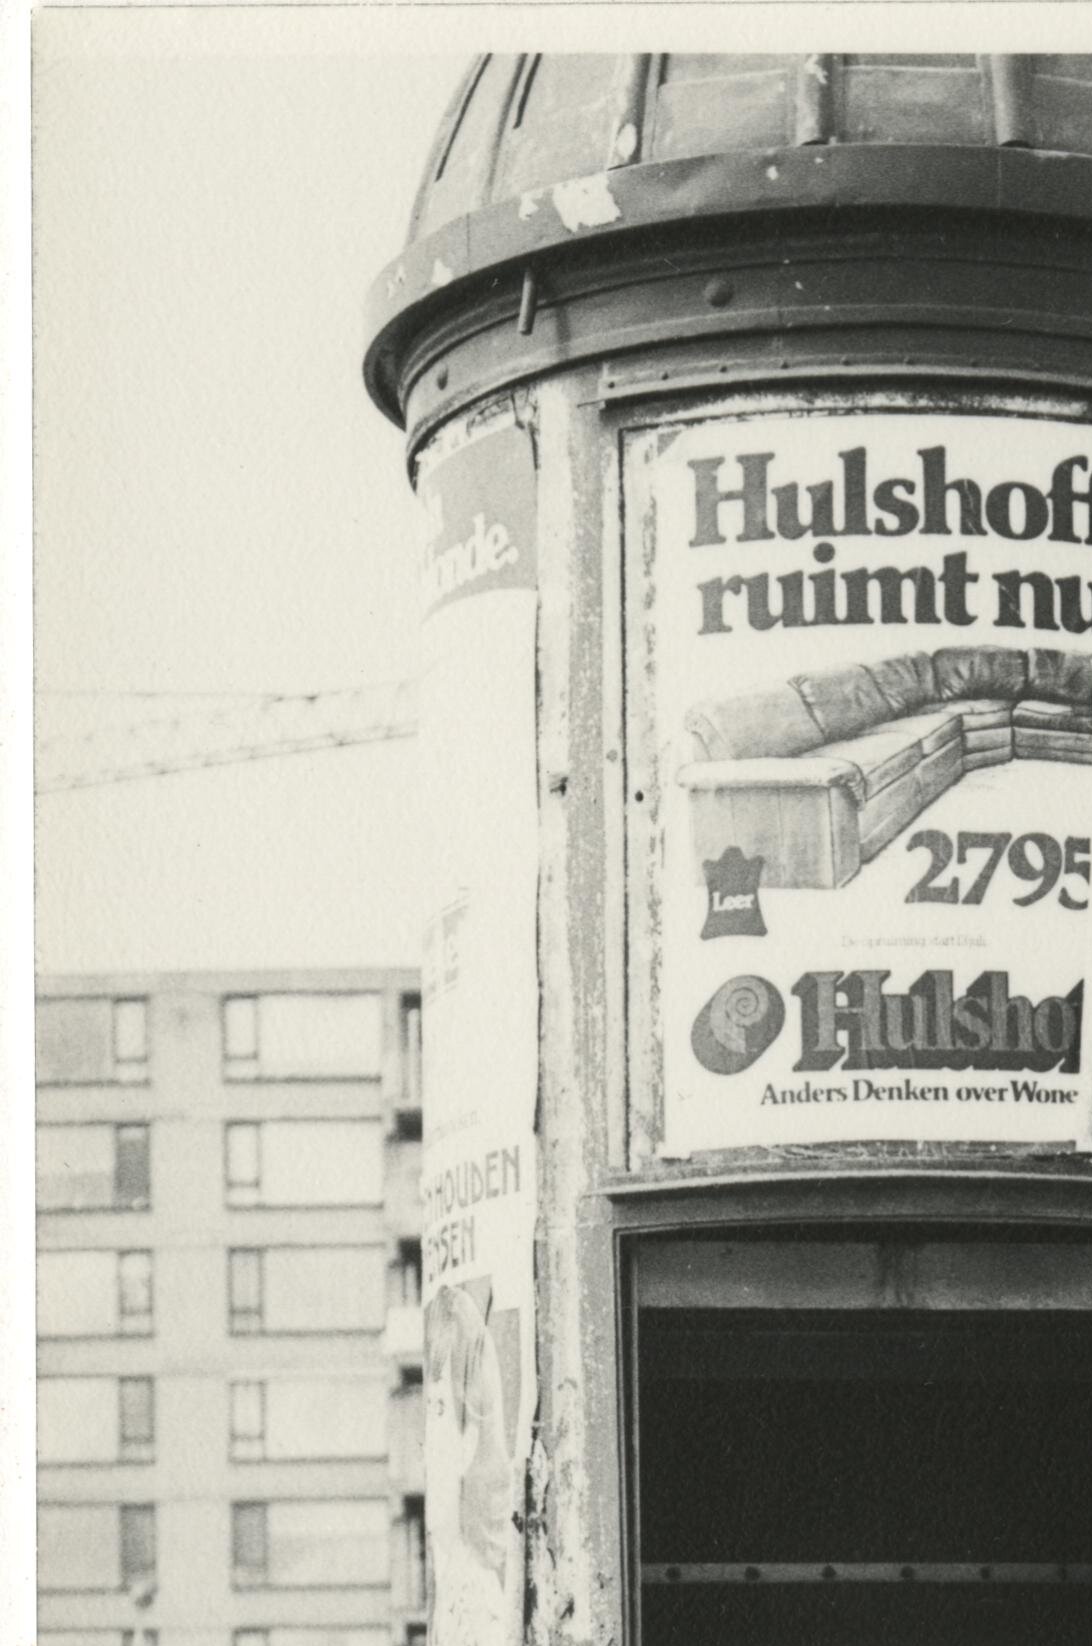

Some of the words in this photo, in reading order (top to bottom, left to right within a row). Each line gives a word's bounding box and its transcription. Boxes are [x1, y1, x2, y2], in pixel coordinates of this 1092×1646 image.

[695, 540, 979, 636] ruimt
[712, 890, 756, 912] Leer
[903, 829, 1092, 912] 2795
[790, 968, 1085, 1076] Hulsho
[760, 1080, 848, 1106] Anders
[852, 1078, 949, 1102] Denken
[955, 1085, 1009, 1102] over
